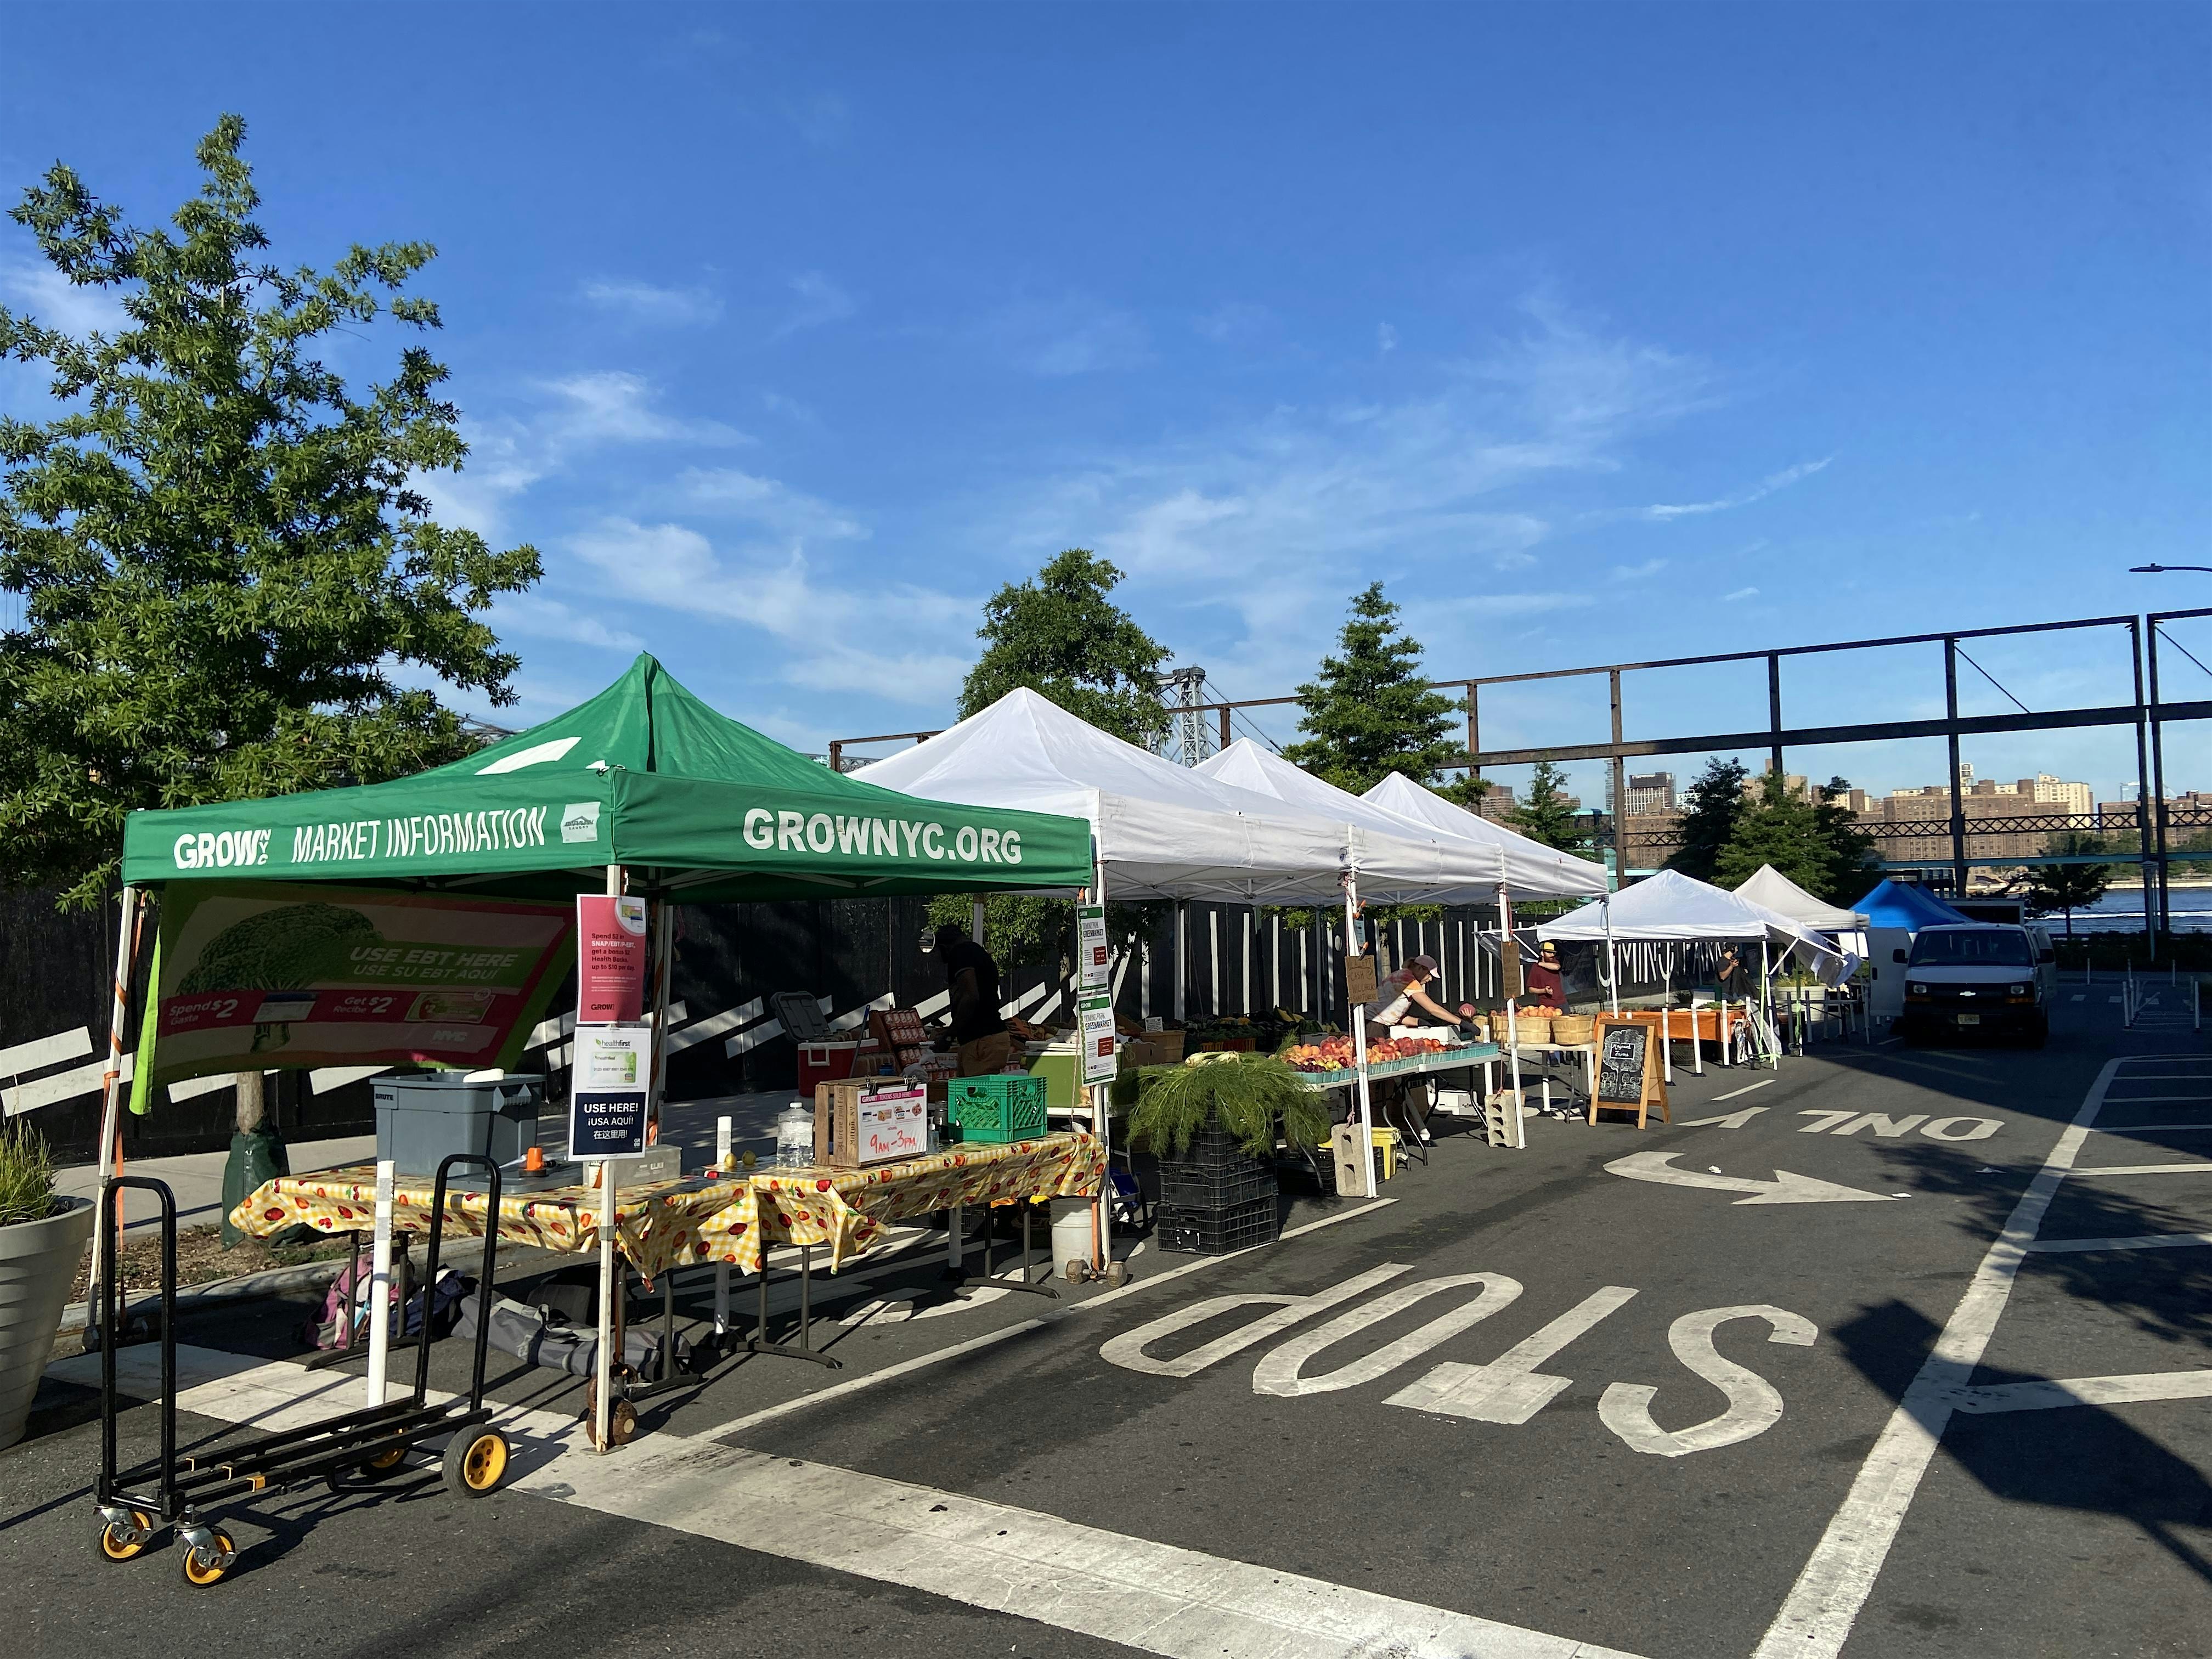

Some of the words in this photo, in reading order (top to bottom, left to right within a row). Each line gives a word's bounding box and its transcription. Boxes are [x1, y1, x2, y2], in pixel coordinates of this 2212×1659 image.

[291, 820, 381, 863] MARKET
[385, 806, 547, 857] INFORMATION
[743, 808, 1022, 864] GROWNYC.ORG
[173, 830, 261, 870] GROW
[349, 946, 403, 962] USE
[403, 949, 455, 966] EBT
[454, 952, 518, 967] HERE
[353, 964, 390, 975] USE
[391, 966, 417, 977] SU
[419, 967, 455, 979] EBT
[344, 996, 367, 1006] Get
[169, 1000, 212, 1017] Spend
[211, 998, 239, 1019] $2
[333, 1006, 367, 1014] Recibe
[171, 1014, 199, 1025] Gasta
[1084, 1013, 1097, 1023] DOMINO
[1097, 1012, 1105, 1020] PARK
[1085, 1019, 1111, 1030] GREENMARKET
[601, 1039, 630, 1047] healthfirst
[584, 1103, 606, 1113] USE
[609, 1103, 639, 1113] HERE!
[588, 1118, 609, 1126] ¡USA
[611, 1115, 634, 1126] AQUÍ!
[1675, 1106, 2005, 1141] ONLY
[1098, 1262, 1819, 1458] STOP
